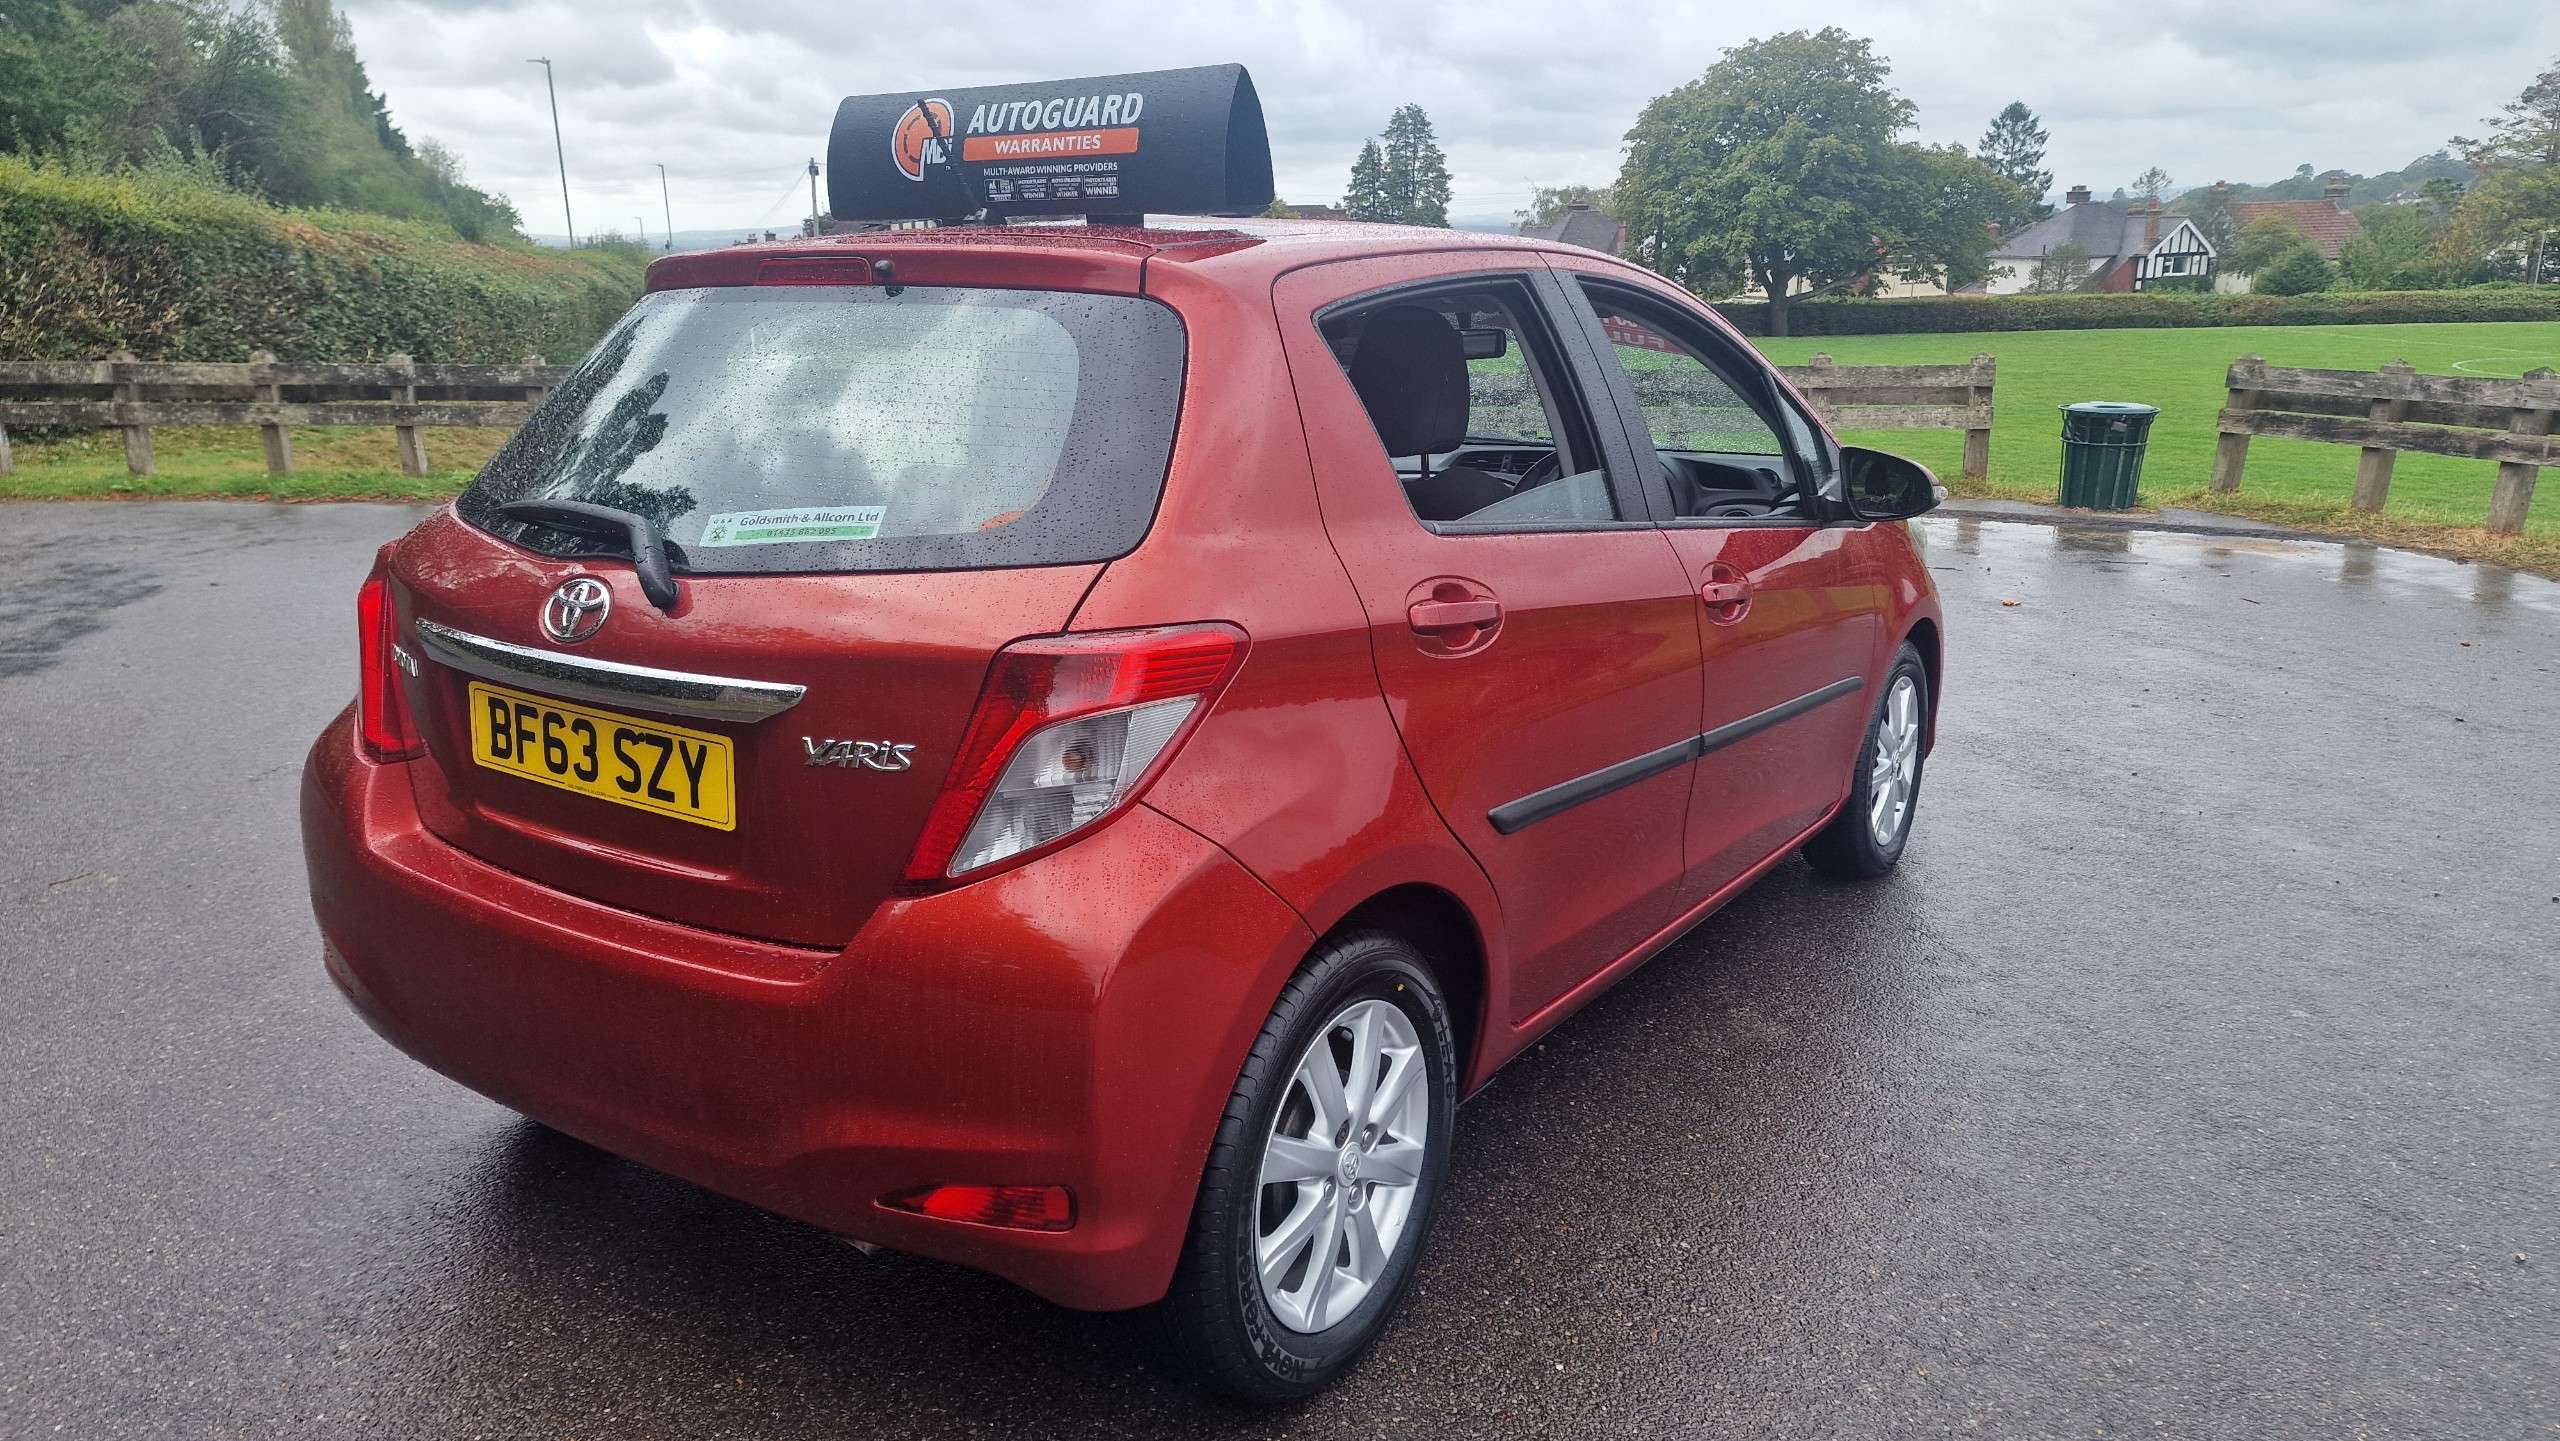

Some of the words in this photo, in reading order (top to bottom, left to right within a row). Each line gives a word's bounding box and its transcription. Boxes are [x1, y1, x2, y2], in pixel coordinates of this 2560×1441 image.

[966, 92, 1145, 134] AUTOGUARD
[994, 135, 1102, 155] WARRANTIES
[983, 165, 1036, 177] MULTI-AWARD
[1036, 163, 1073, 175] WINNING
[1073, 161, 1118, 173] PROVIDERS
[1085, 185, 1118, 196] WINNER
[739, 513, 801, 527] Goldsmith
[801, 512, 810, 523] &
[812, 511, 855, 523] Allcorn
[857, 511, 879, 522] Ltd
[488, 696, 599, 783] BF63
[614, 727, 708, 809] SZY
